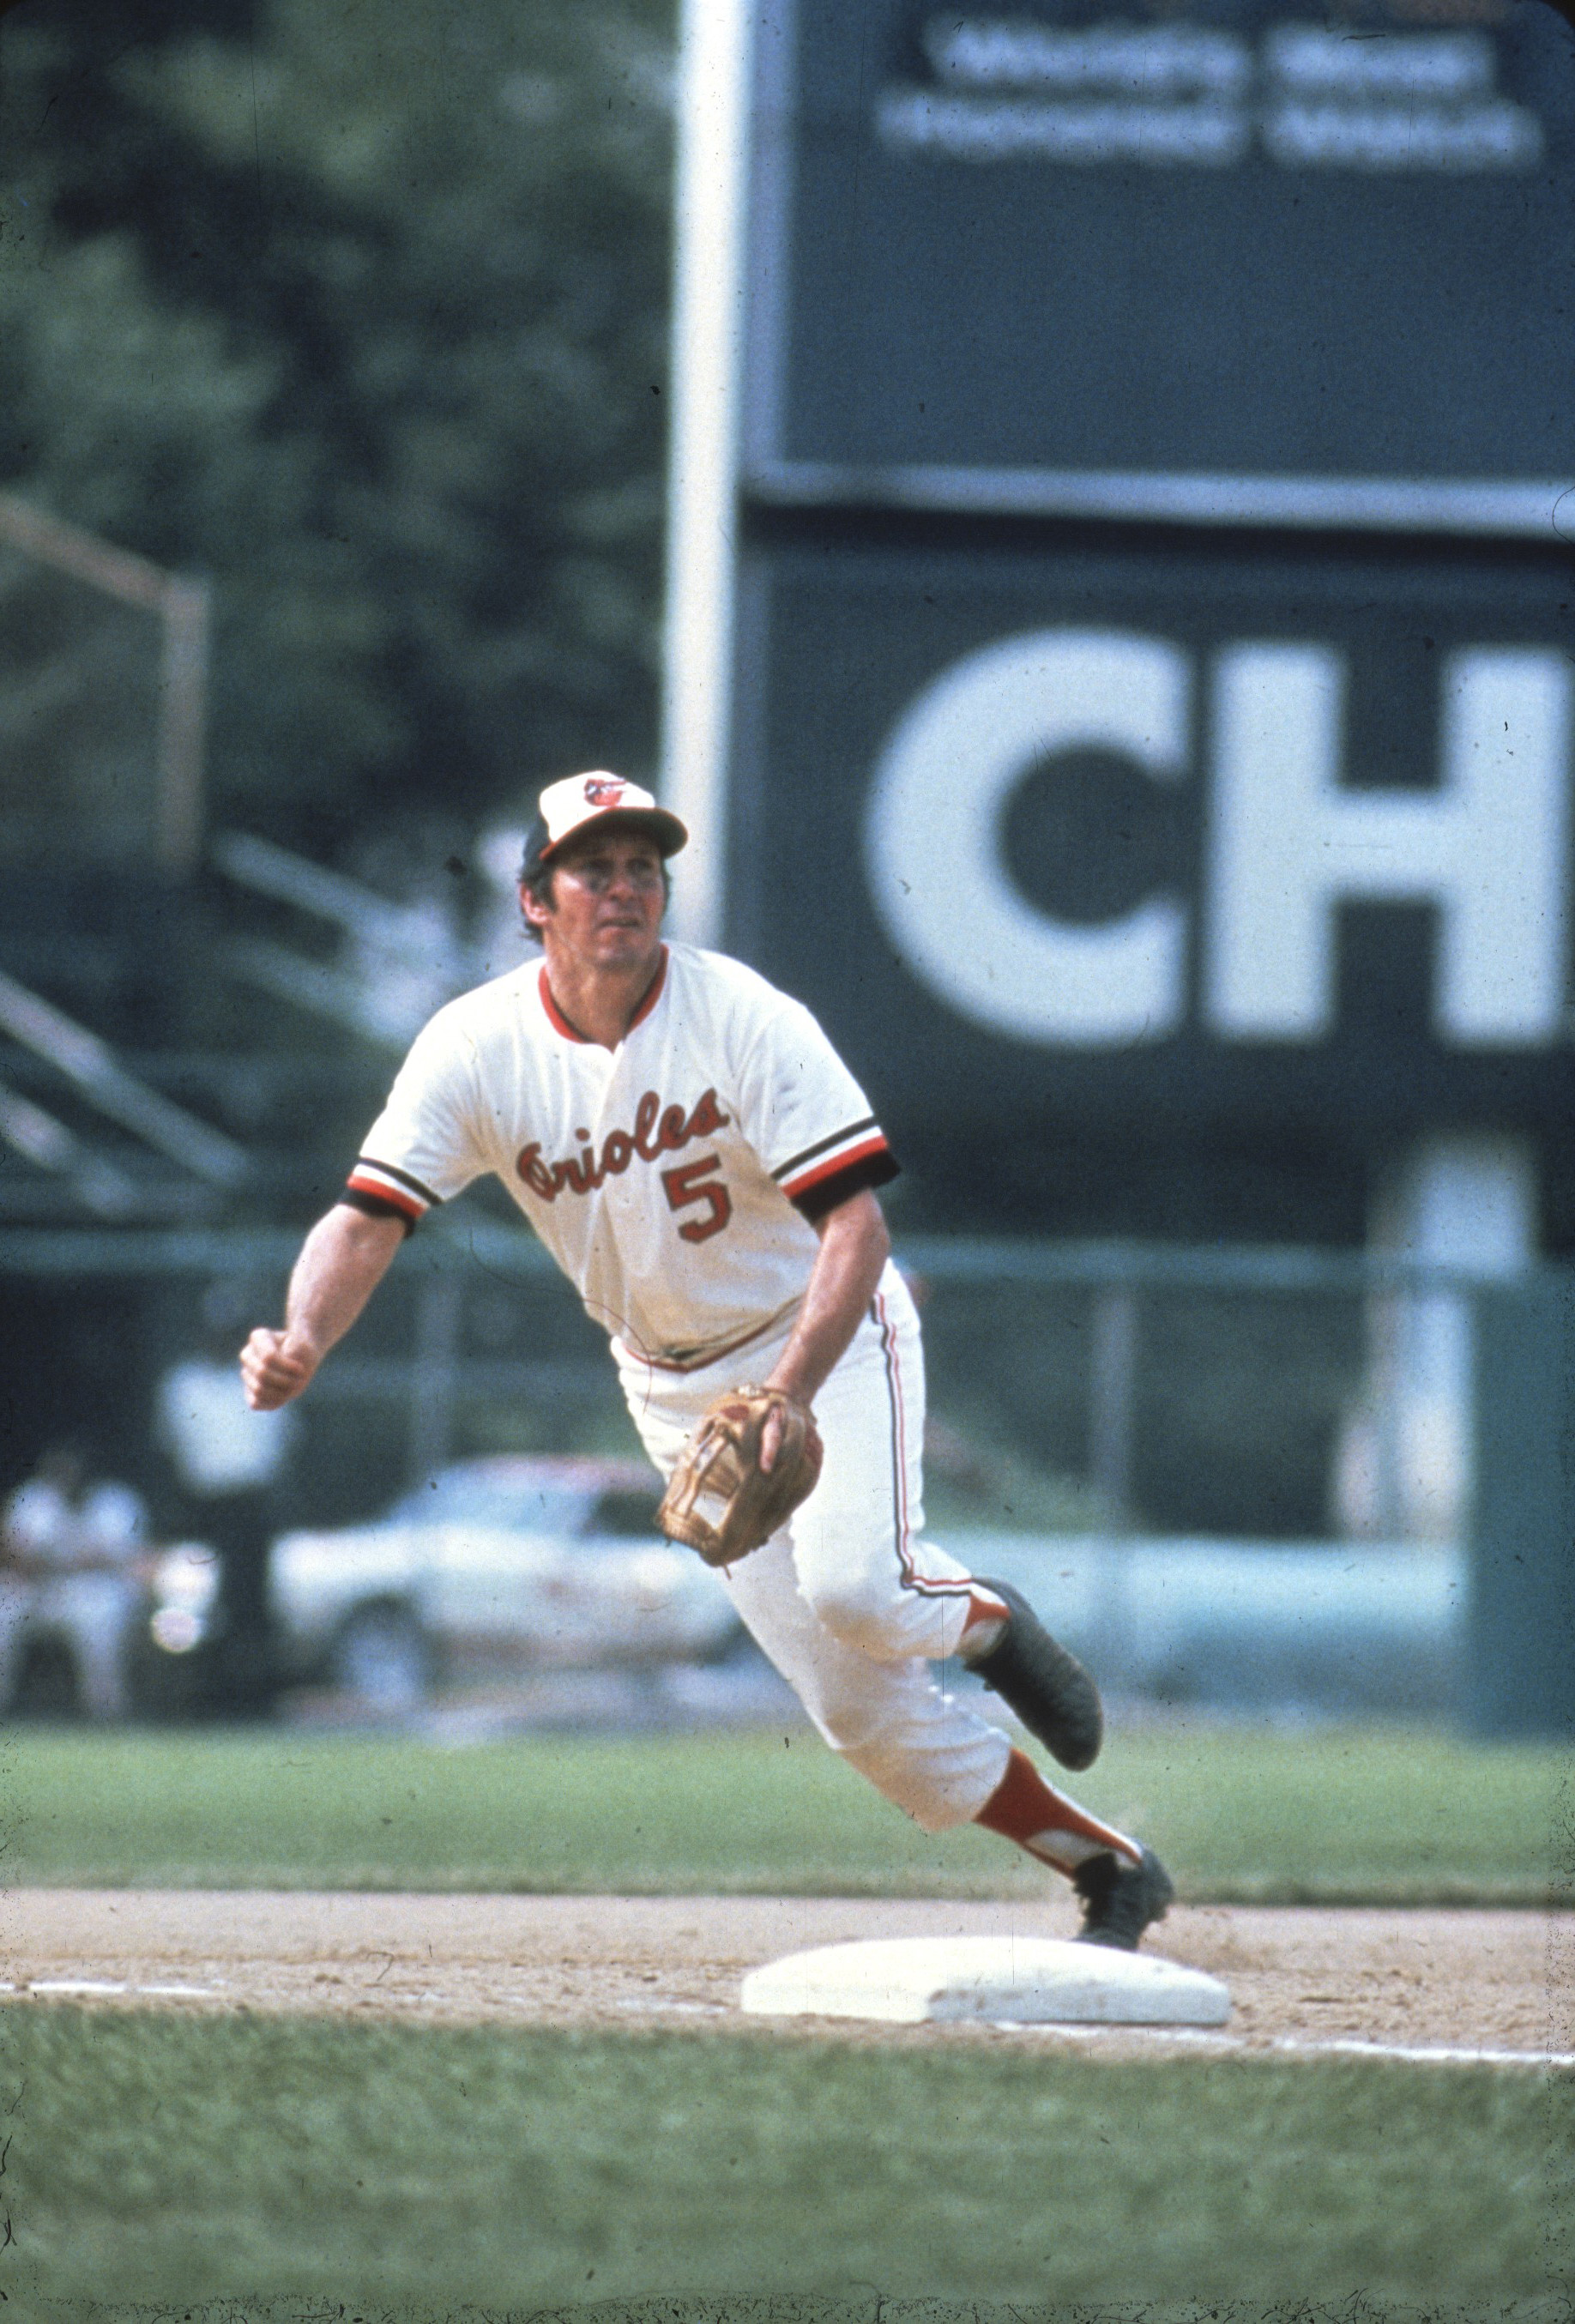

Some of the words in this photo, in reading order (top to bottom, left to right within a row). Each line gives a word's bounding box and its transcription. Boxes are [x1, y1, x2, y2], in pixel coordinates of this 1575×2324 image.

[863, 625, 1569, 1047] CH
[516, 1087, 730, 1204] Orioles
[661, 1151, 733, 1245] 5
